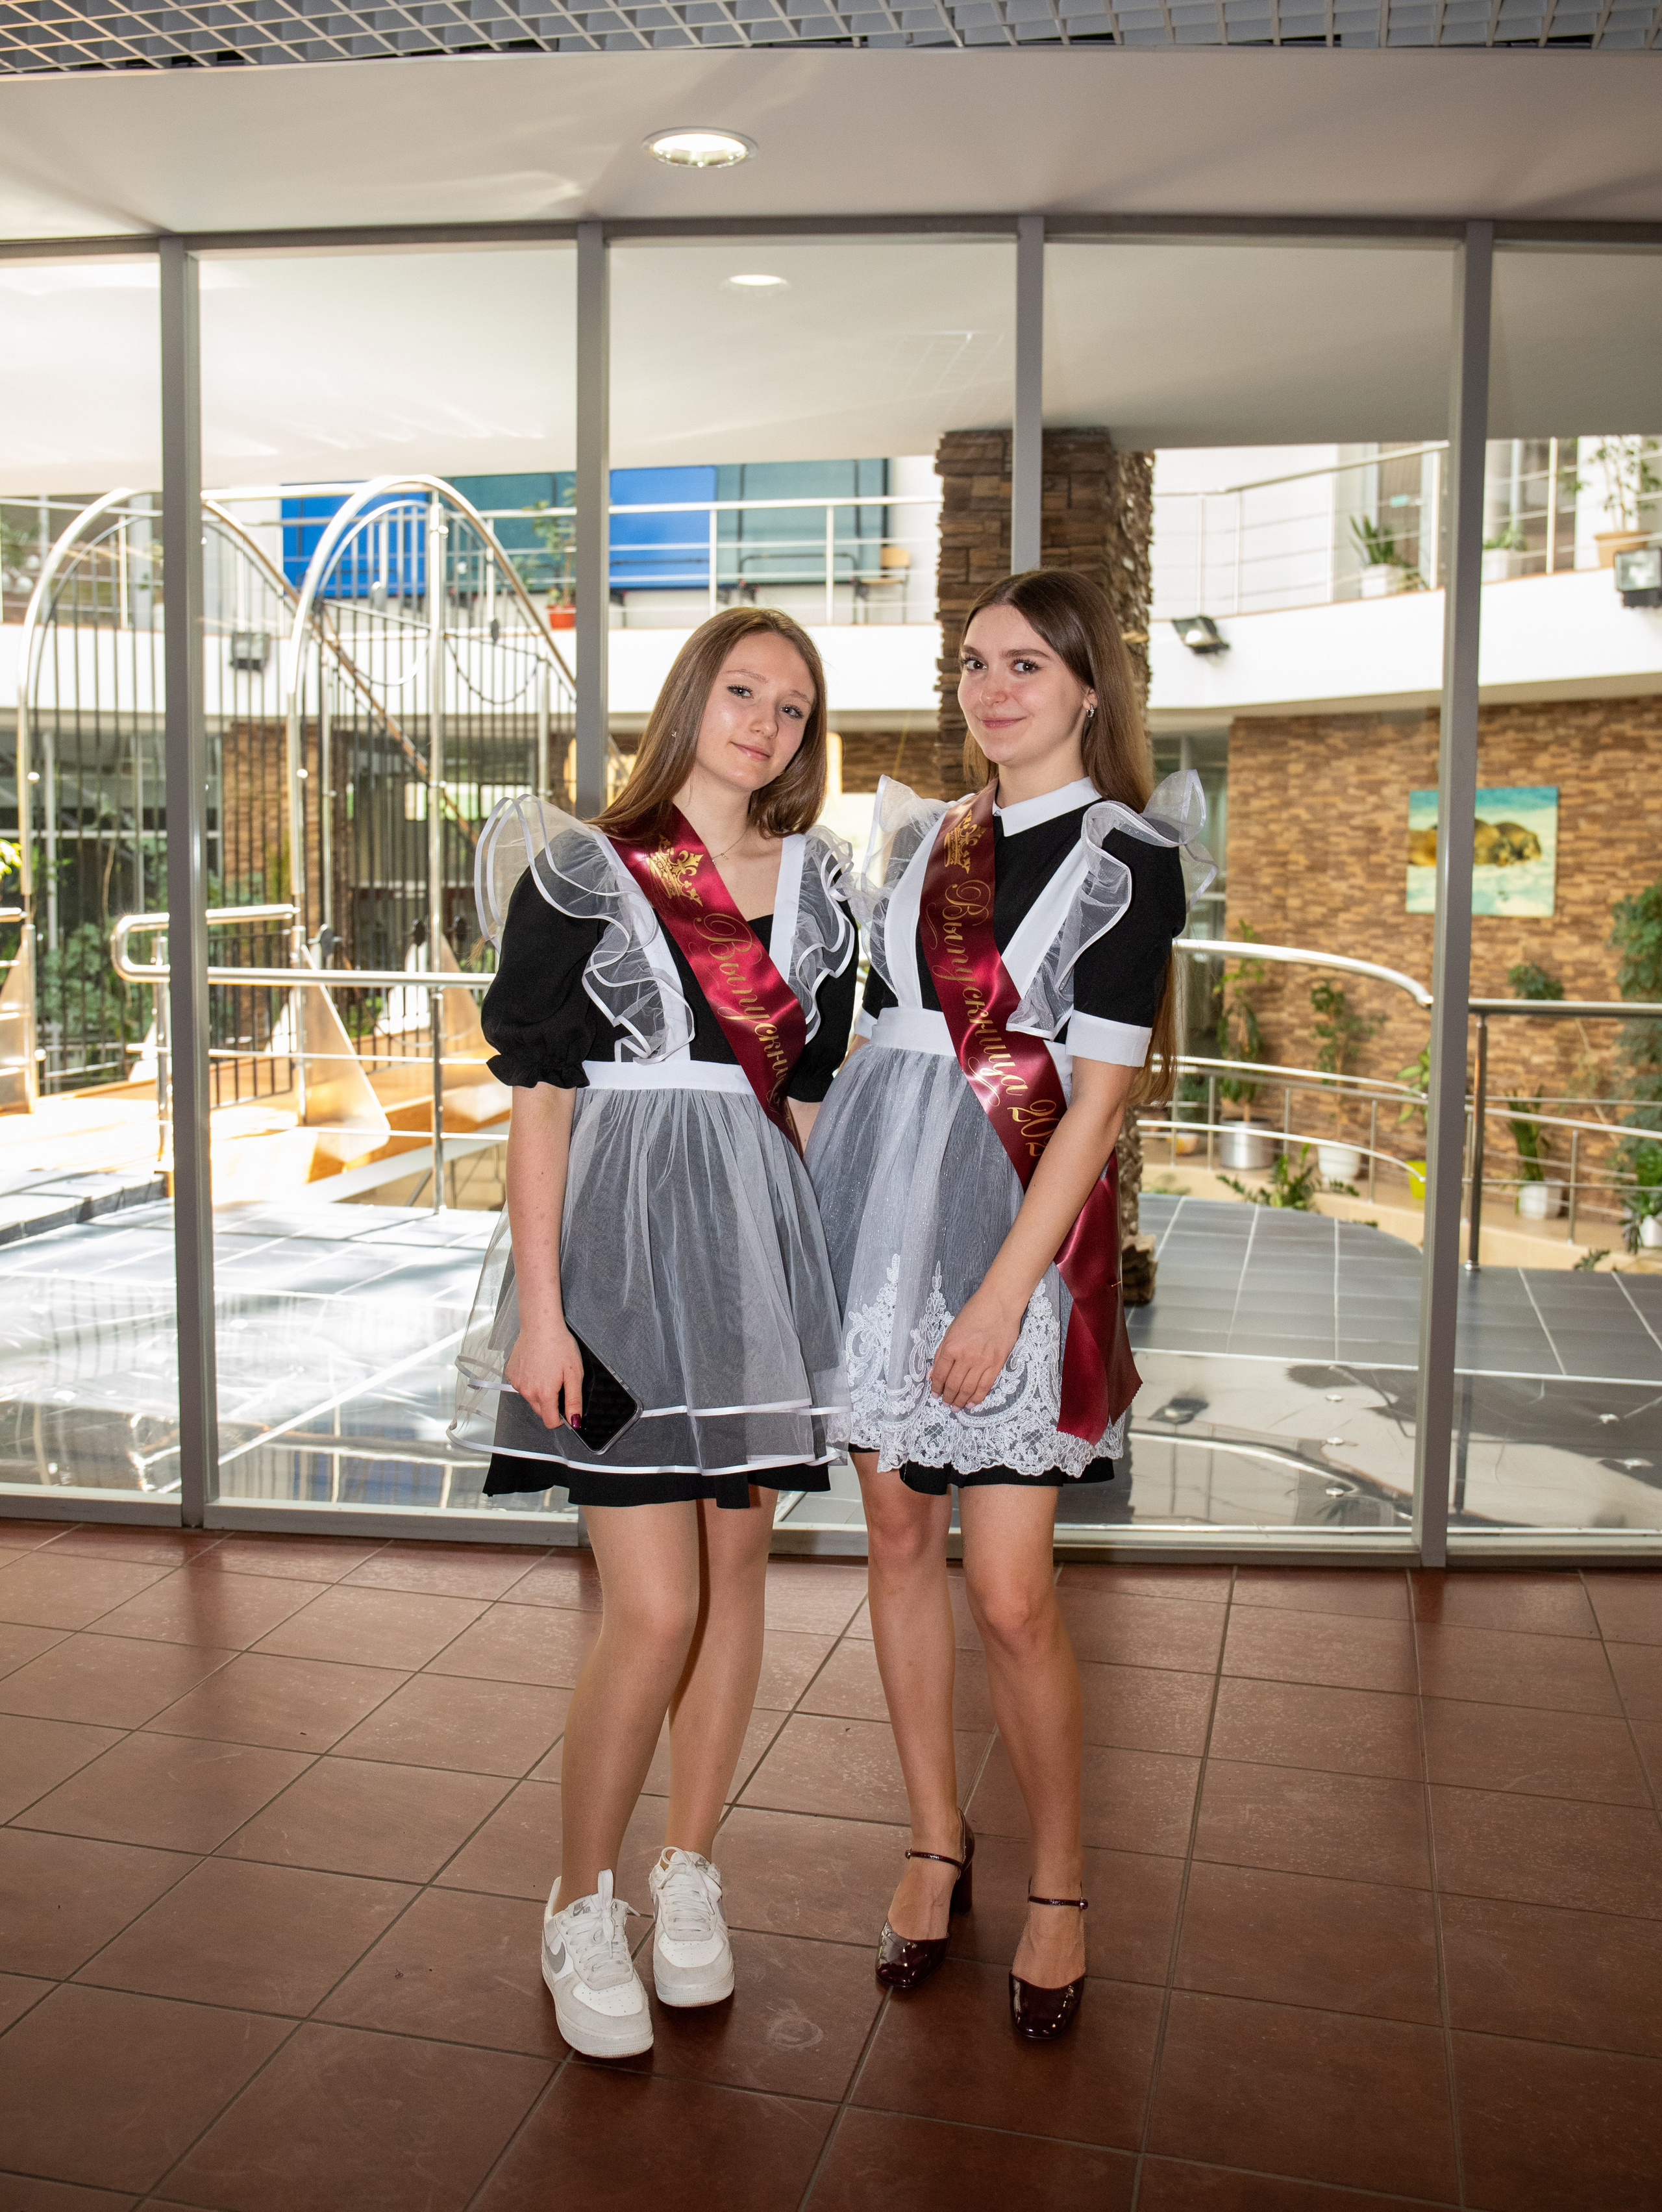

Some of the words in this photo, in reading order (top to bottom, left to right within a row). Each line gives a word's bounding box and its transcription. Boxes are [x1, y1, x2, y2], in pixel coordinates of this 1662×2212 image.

[693, 913, 789, 1105] Выпускни
[932, 879, 1029, 1097] Выпускница
[1007, 1099, 1060, 1157] 202
[573, 1901, 584, 1913] NIKE
[582, 1906, 591, 1914] AIR
